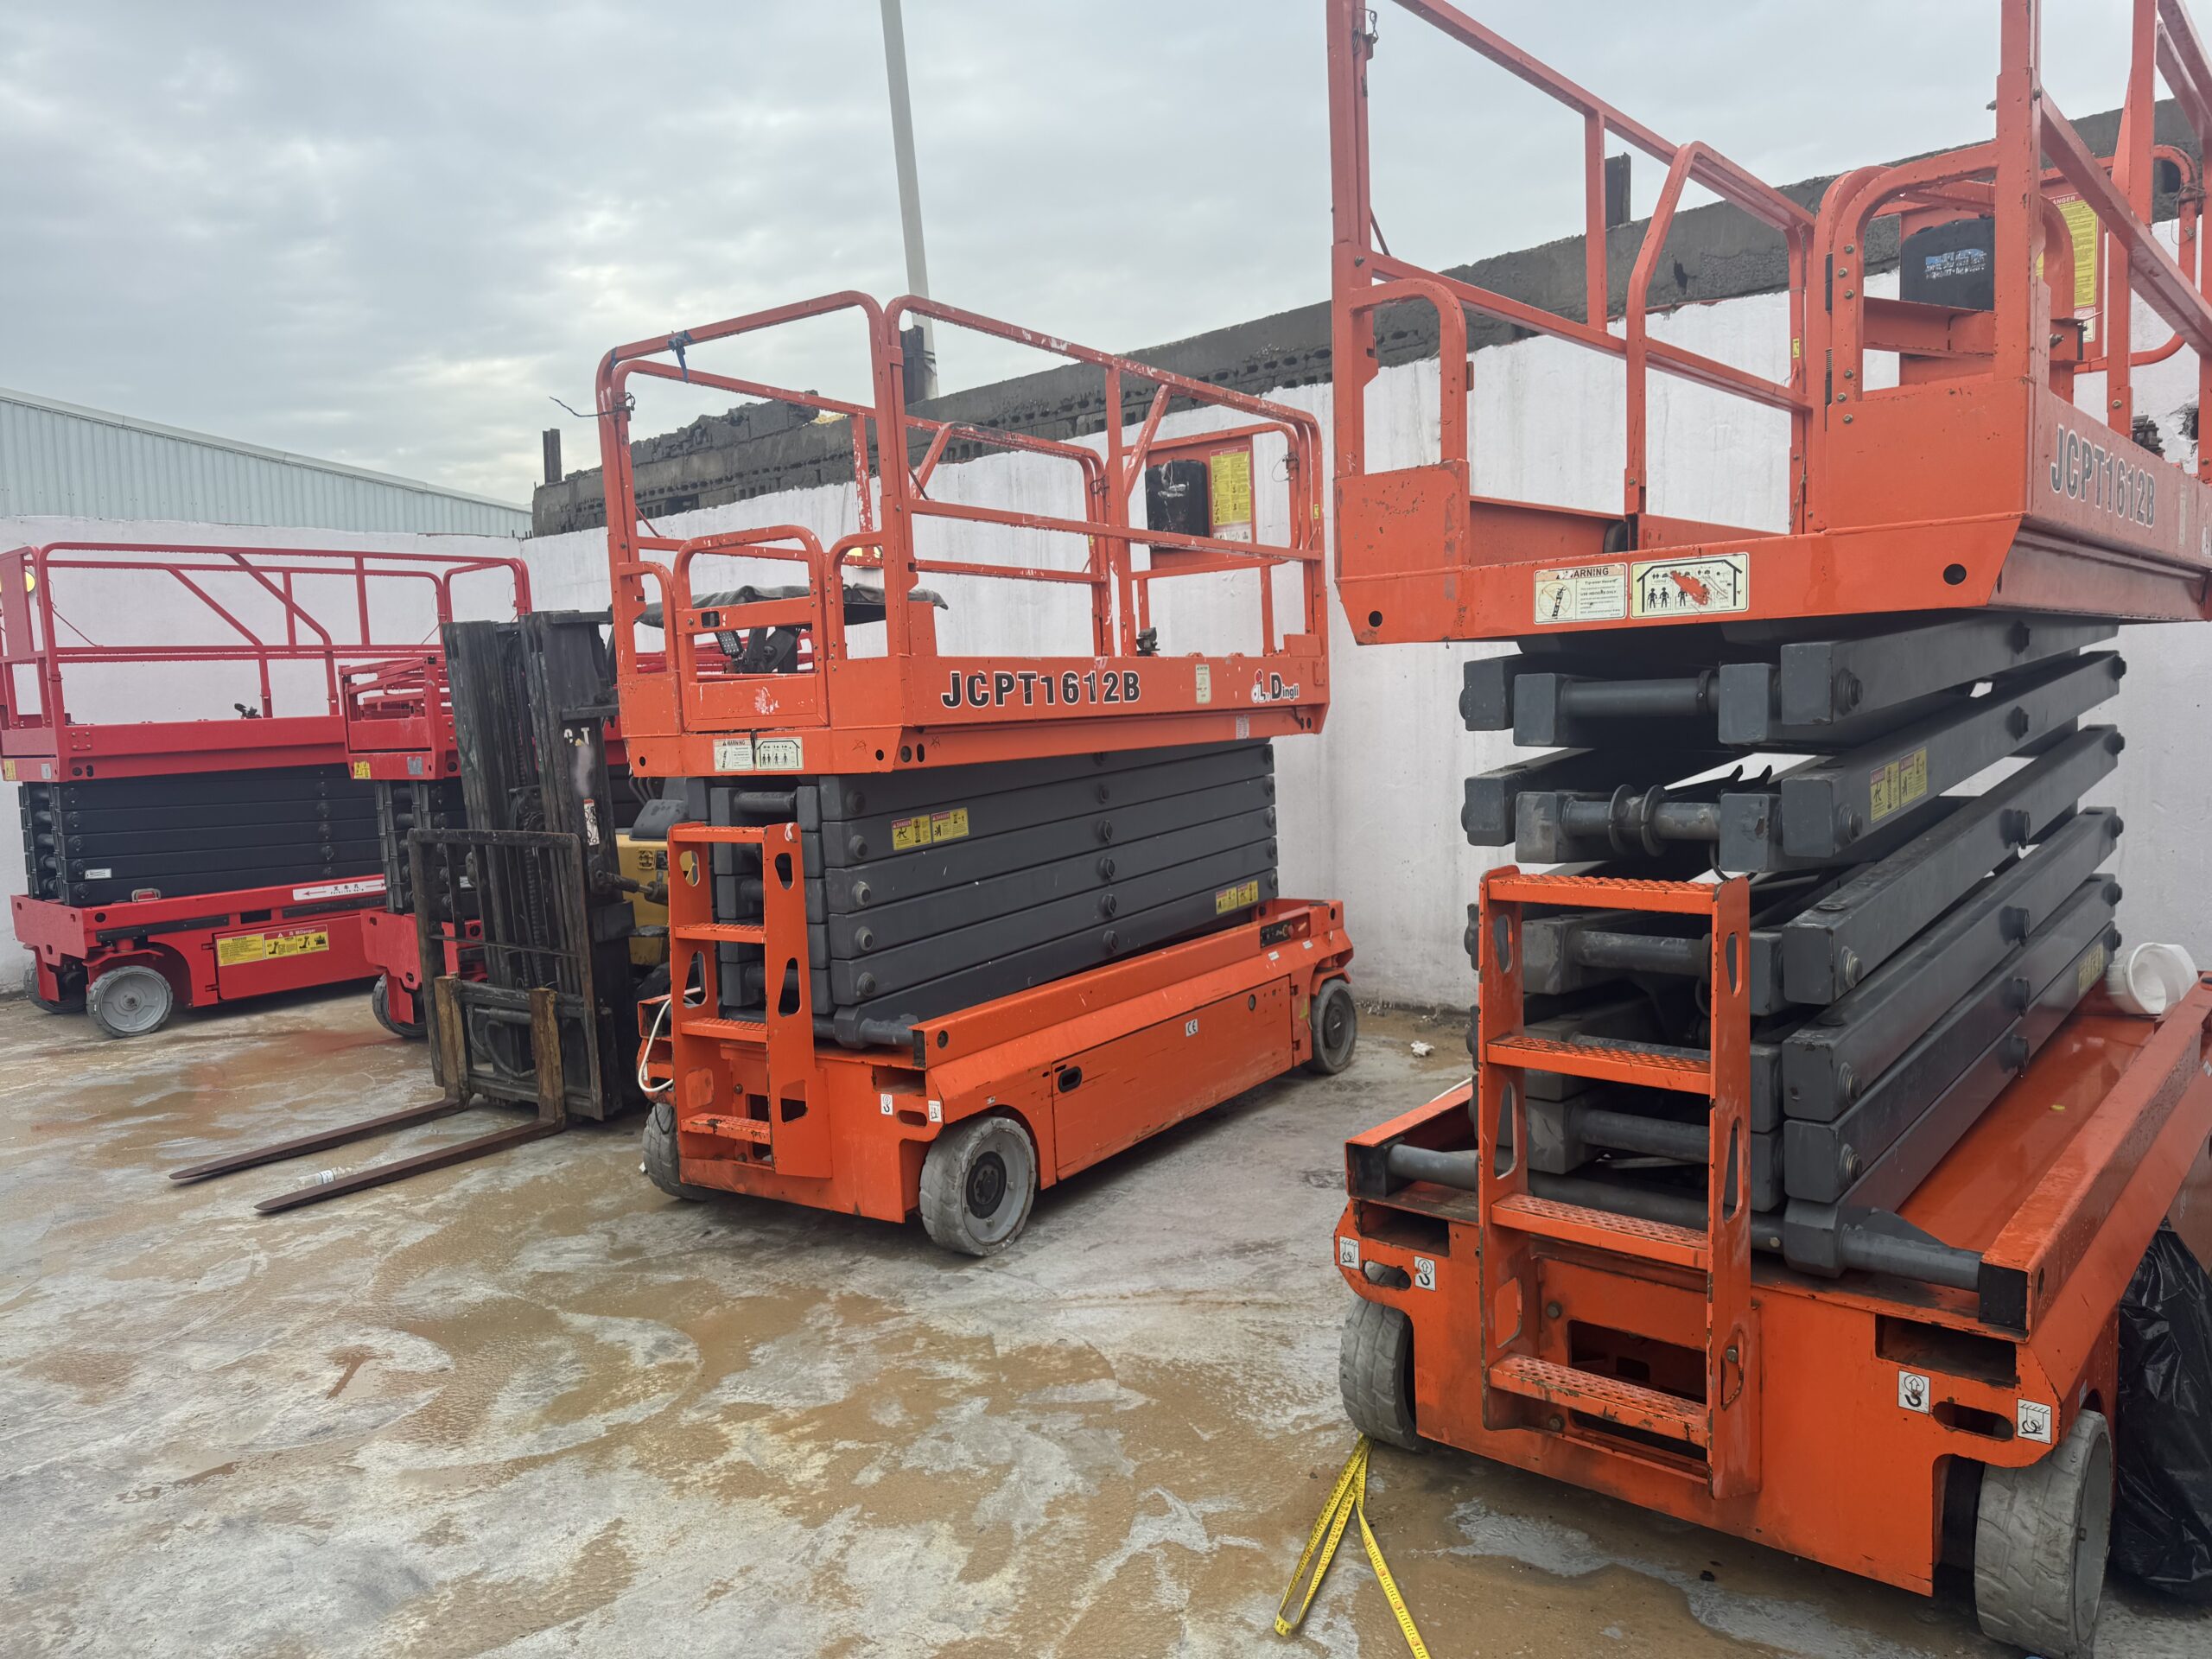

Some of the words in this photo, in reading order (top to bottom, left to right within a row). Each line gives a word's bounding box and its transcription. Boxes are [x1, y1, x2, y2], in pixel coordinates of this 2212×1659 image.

[2053, 195, 2075, 205] ANGER
[2050, 423, 2155, 529] JCPT1612B
[1570, 567, 1609, 578] ARNING
[941, 671, 1141, 709] JCPT1612B
[1270, 672, 1300, 701] Dingli
